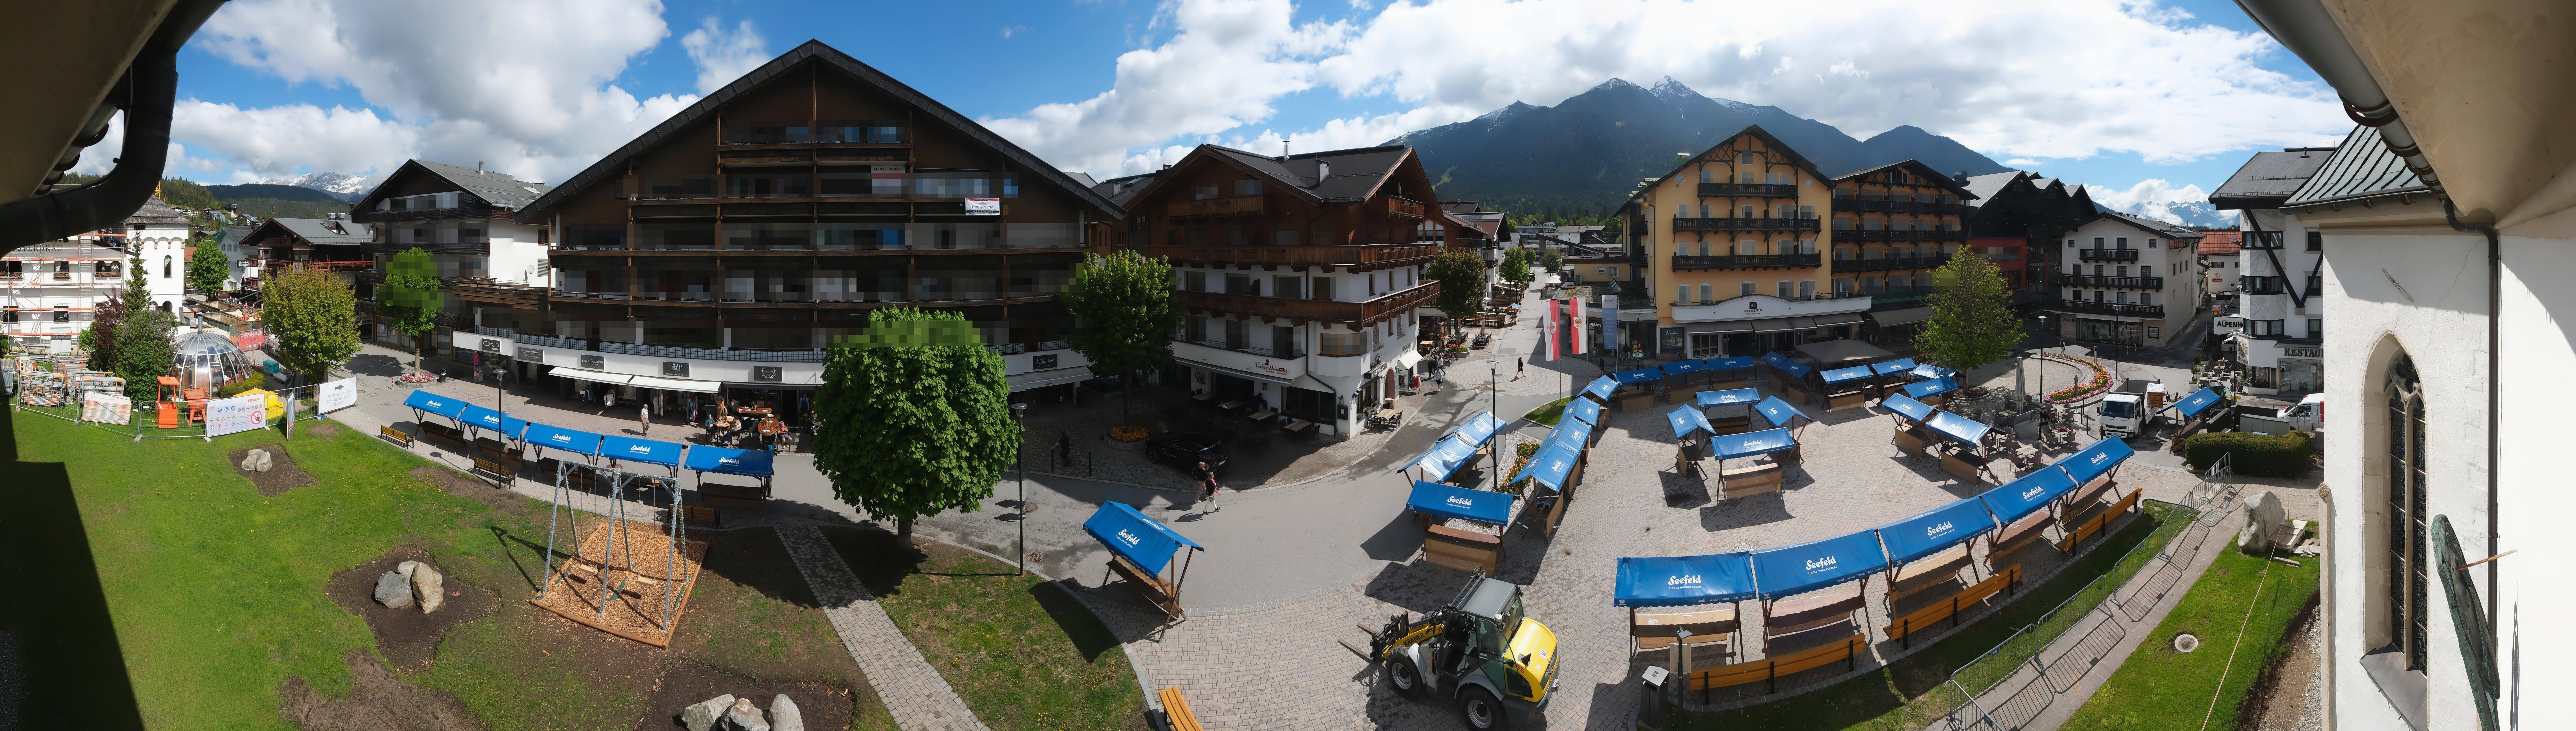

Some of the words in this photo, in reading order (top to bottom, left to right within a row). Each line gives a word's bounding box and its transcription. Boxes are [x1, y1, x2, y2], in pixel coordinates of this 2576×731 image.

[1402, 343, 1411, 351] SAILER
[671, 363, 682, 373] My
[1268, 365, 1289, 373] Weinstube
[1372, 364, 1386, 377] RESTAURANT
[327, 395, 350, 403] KONGRESSZENTRUM
[2091, 452, 2107, 463] Seefeld
[2023, 485, 2043, 499] Seefeld
[1447, 496, 1472, 505] Seefeld
[1927, 520, 1953, 536] Seefeld
[1118, 529, 1140, 545] Seefeld
[1121, 538, 1133, 548] HOCHPLATEAU
[1806, 555, 1836, 570] Seefeld
[1667, 575, 1702, 585] Seefeld
[1403, 633, 1425, 645] KRAMER
